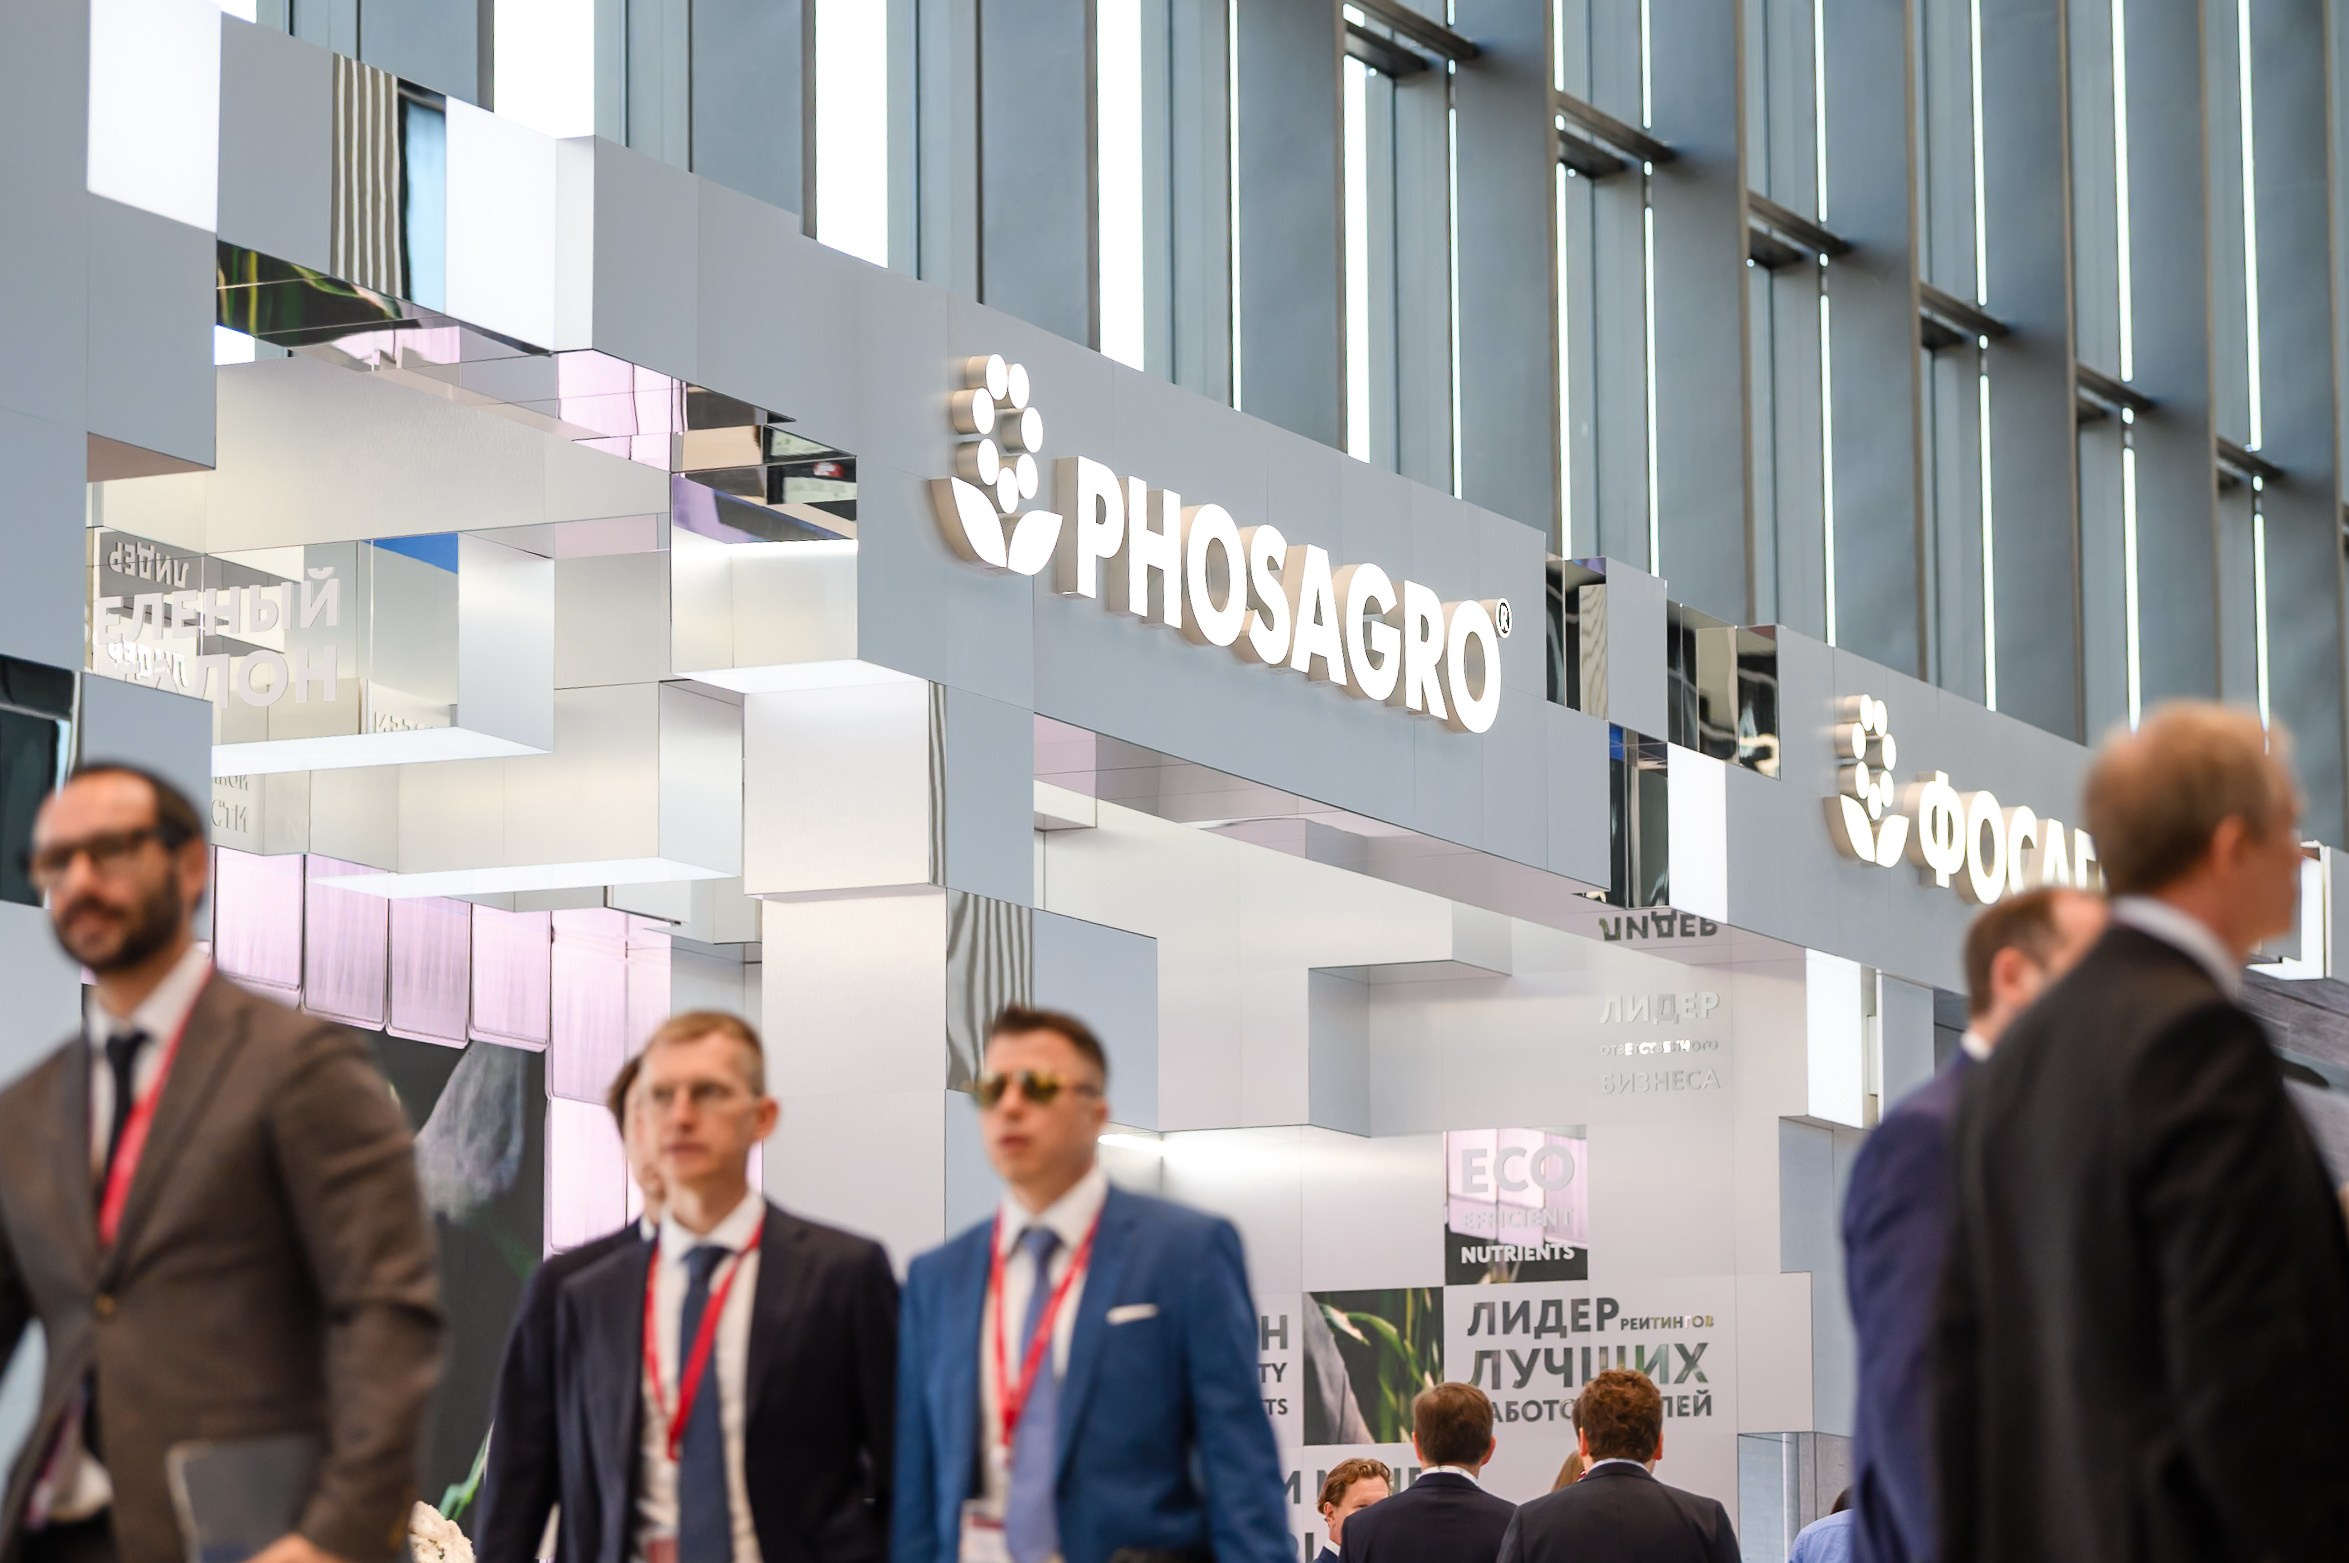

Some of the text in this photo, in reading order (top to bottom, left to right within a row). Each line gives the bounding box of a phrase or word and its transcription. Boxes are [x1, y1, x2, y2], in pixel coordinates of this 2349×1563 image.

[85, 566, 341, 645] ЕЛЕНЫЙ
[1918, 770, 2104, 905] ФОСАГ
[1600, 991, 1720, 1025] ЛИДЕР
[1602, 1067, 1721, 1095] БИЗНЕСА
[1461, 1144, 1575, 1194] ECO
[1464, 1208, 1574, 1230] EFFICIENT
[1461, 1243, 1576, 1265] NUTRIENTS
[1467, 1297, 1620, 1339] ЛИДЕР
